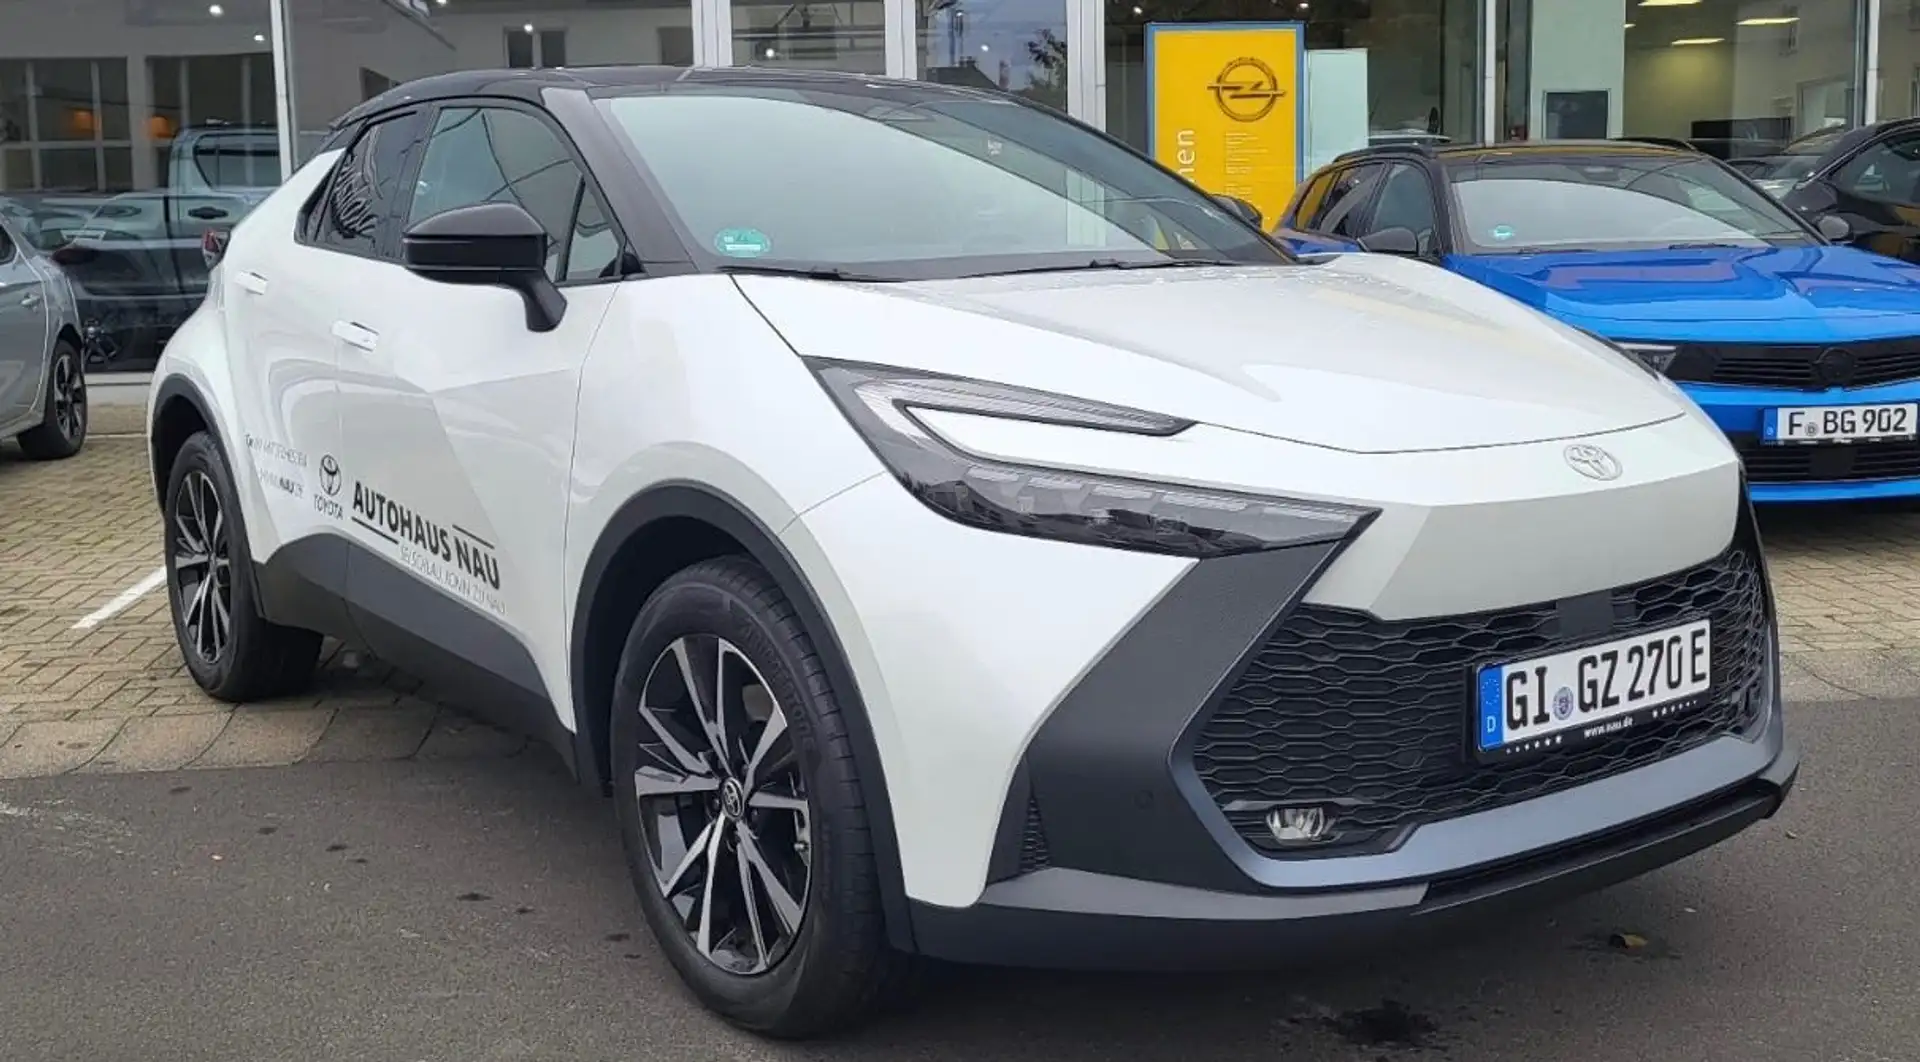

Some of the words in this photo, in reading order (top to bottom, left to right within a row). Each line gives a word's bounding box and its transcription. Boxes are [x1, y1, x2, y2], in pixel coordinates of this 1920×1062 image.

[1788, 411, 1805, 435] F
[1823, 410, 1856, 434] BG
[1863, 408, 1907, 432] 902
[313, 494, 343, 520] TOYOTA
[353, 481, 451, 562] AUTOHAUS
[455, 537, 500, 590] NAU
[1505, 665, 1551, 731] GI
[1577, 650, 1620, 713] GZ
[1627, 635, 1682, 702] 270
[1690, 627, 1707, 684] E
[1486, 716, 1497, 733] D
[1583, 715, 1633, 739] www.nau.de
